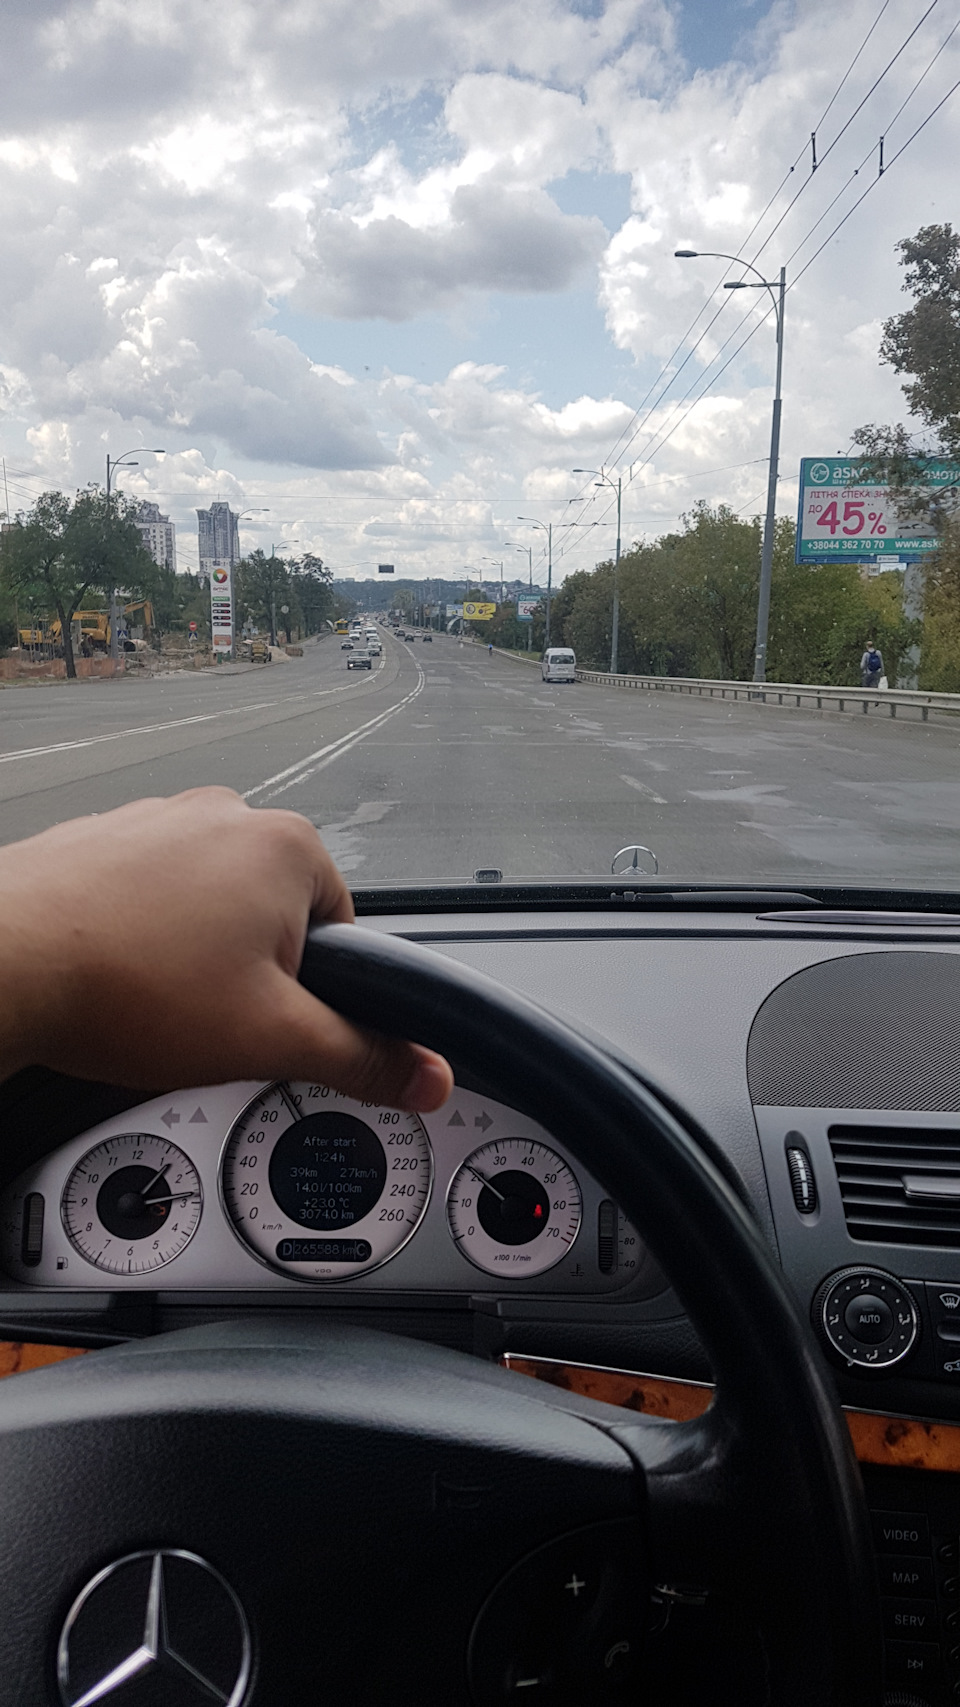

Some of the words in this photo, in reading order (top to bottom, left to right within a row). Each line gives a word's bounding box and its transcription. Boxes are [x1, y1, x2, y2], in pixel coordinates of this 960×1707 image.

[810, 491, 838, 499] ЛІТНЯ
[842, 490, 870, 498] СПЕКА
[808, 504, 822, 514] ДО
[816, 501, 887, 535] 45%
[807, 541, 839, 550] +38044
[842, 540, 858, 549] 362
[861, 540, 872, 548] 70
[874, 540, 885, 548] 70
[307, 1086, 329, 1098] 120
[261, 1111, 278, 1122] 80
[378, 1113, 399, 1124] 180
[248, 1132, 264, 1144] 60
[304, 1136, 329, 1147] After
[334, 1138, 356, 1147] start
[388, 1133, 414, 1146] 200
[132, 1150, 143, 1160] 12
[108, 1157, 118, 1166] 11
[240, 1156, 257, 1168] 40
[392, 1158, 418, 1170] 220
[494, 1156, 506, 1166] 30
[522, 1157, 534, 1166] 40
[340, 1167, 377, 1178] 27km/h
[87, 1174, 99, 1184] 10
[175, 1174, 182, 1183] 2
[544, 1174, 557, 1184] 50
[240, 1183, 258, 1196] 20
[390, 1184, 416, 1197] 240
[81, 1198, 88, 1206] 9
[180, 1198, 188, 1208] 3
[462, 1198, 472, 1208] 10
[553, 1200, 566, 1210] 60
[249, 1208, 258, 1220] 0
[342, 1210, 354, 1219] km
[379, 1210, 404, 1222] 260
[86, 1222, 92, 1232] 8
[172, 1222, 178, 1232] 4
[468, 1226, 474, 1236] 0
[547, 1228, 560, 1238] 70
[104, 1239, 112, 1249] 7
[152, 1240, 160, 1250] 5
[127, 1246, 133, 1256] 6
[282, 1243, 292, 1256] D
[494, 1254, 510, 1262] x100
[859, 1314, 880, 1324] AUTO
[884, 1528, 918, 1542] VIDEO
[892, 1572, 919, 1584] MAP
[894, 1614, 925, 1627] SERV
